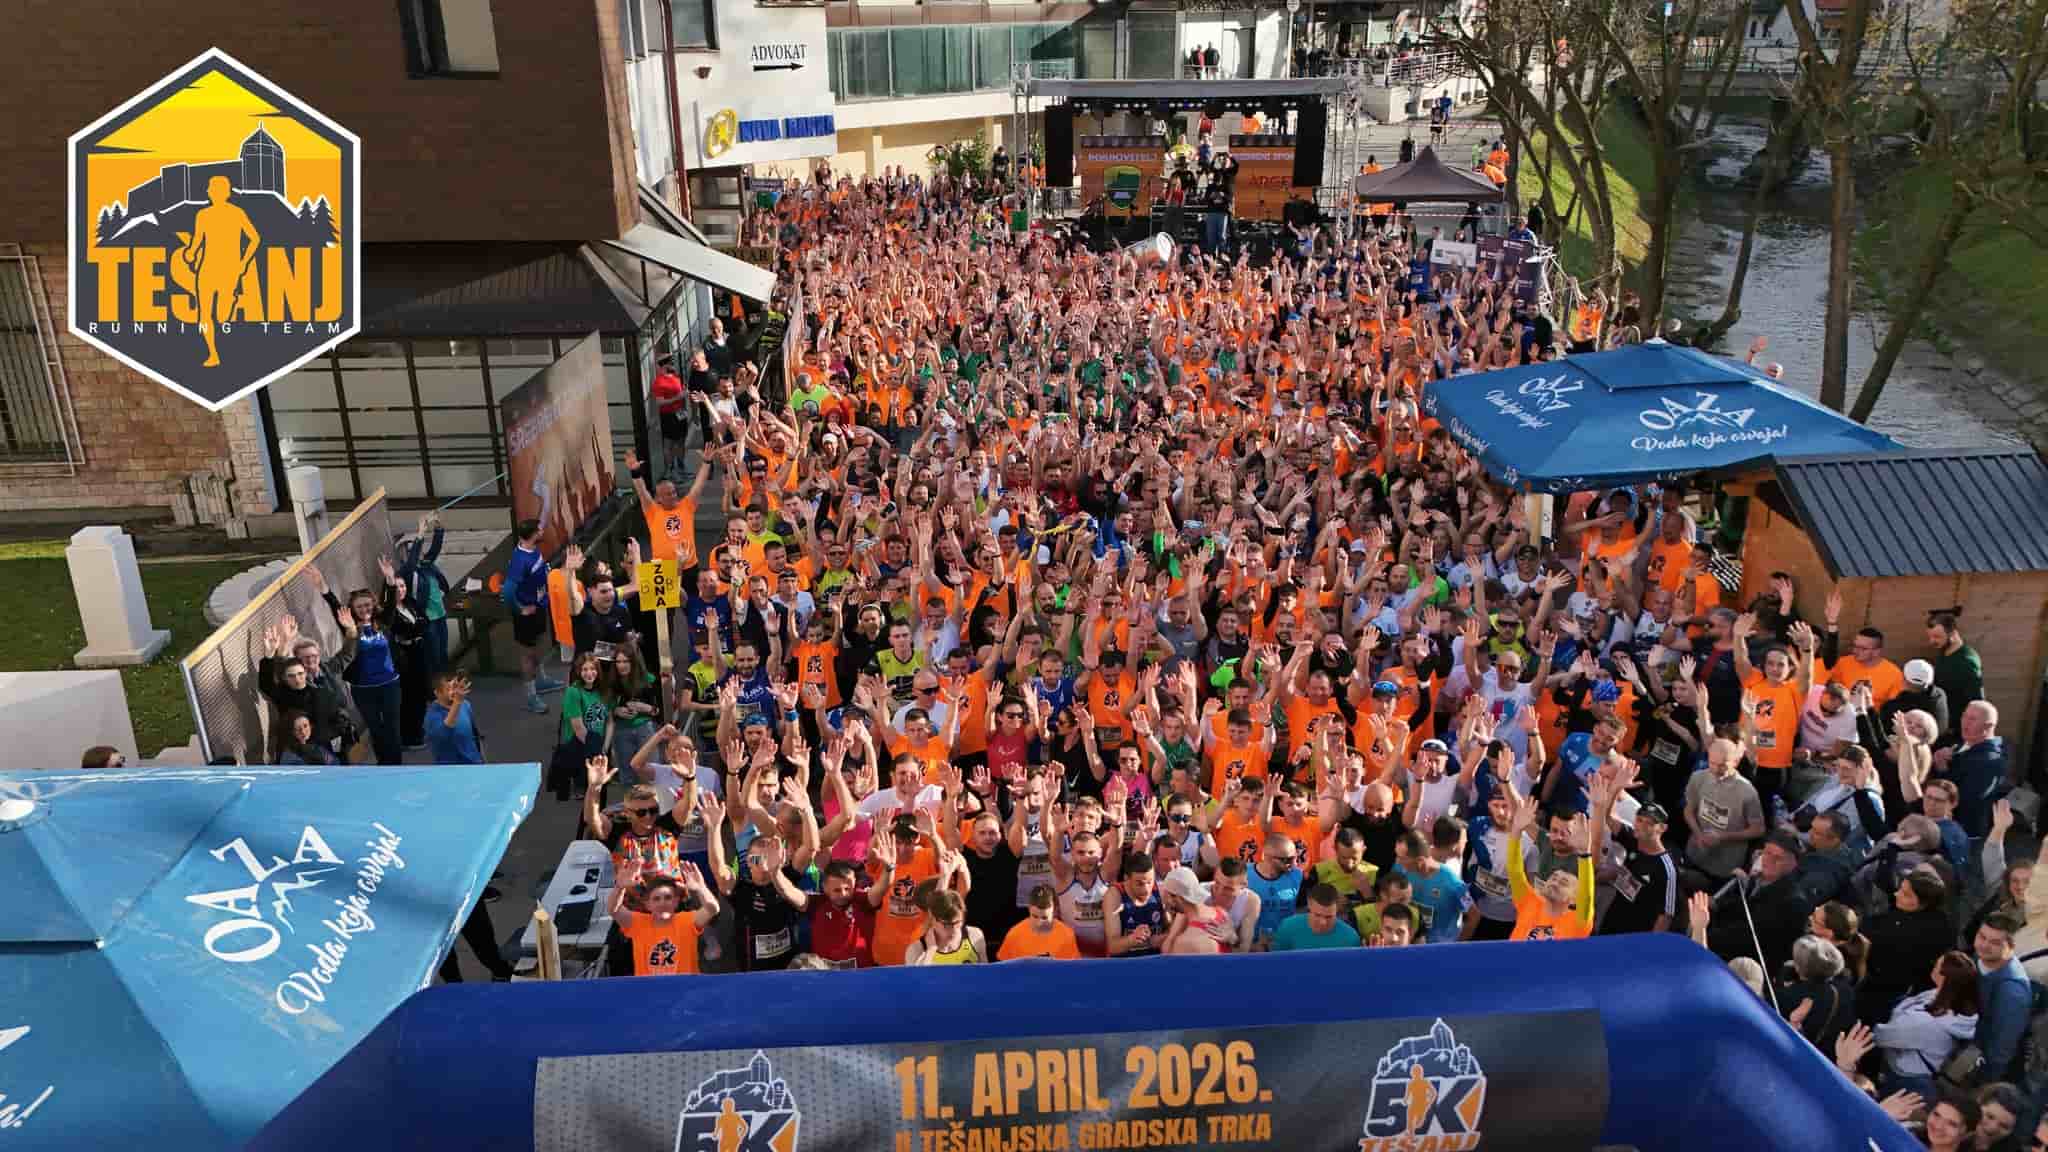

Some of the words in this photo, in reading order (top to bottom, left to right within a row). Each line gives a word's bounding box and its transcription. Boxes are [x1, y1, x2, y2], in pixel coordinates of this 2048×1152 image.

[751, 43, 808, 61] ADVOKAT
[1639, 391, 1756, 430] OAZA
[1631, 435, 1689, 452] Voda
[1692, 432, 1728, 450] koja
[654, 564, 666, 607] ZONA
[184, 824, 345, 963] OAZA
[276, 938, 346, 1015] Voda
[322, 889, 375, 941] koja
[896, 1056, 954, 1120] 11.
[972, 1048, 1110, 1117] APRIL
[1126, 1041, 1272, 1109] 2026.
[1364, 1076, 1487, 1137] 5K
[919, 1121, 1071, 1152] TEŠANJSKA
[1079, 1117, 1197, 1150] GRADSKA
[1207, 1113, 1272, 1143] TRKA
